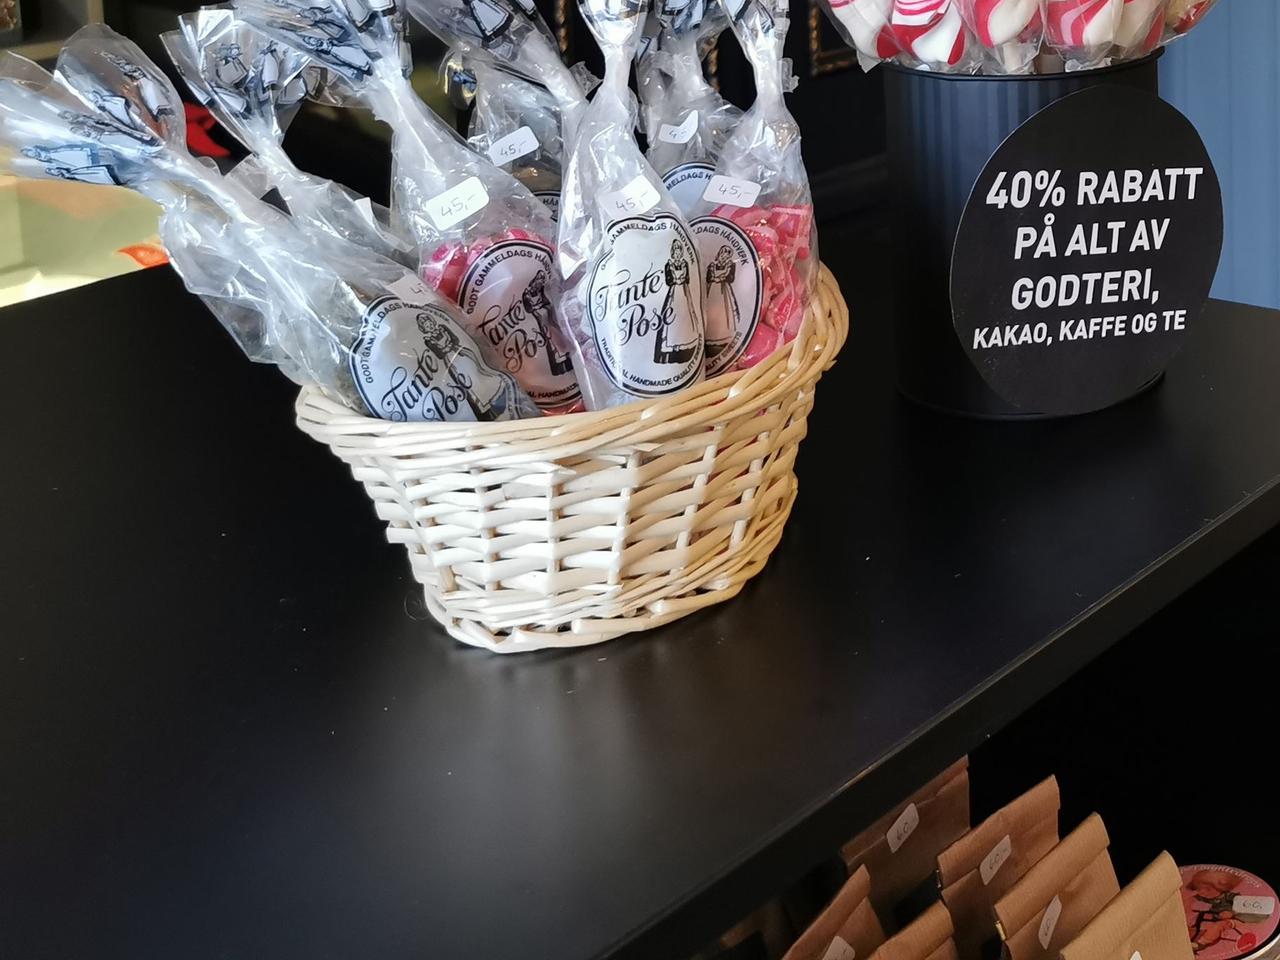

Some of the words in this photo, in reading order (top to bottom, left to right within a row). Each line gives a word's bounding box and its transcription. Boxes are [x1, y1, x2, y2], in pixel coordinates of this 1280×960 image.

[500, 141, 527, 156] 45,-
[615, 191, 649, 209] 45,-
[666, 171, 704, 192] MELDAGS
[718, 183, 753, 199] 45,-
[986, 168, 1066, 209] 40%
[1077, 167, 1203, 205] RABATT
[441, 193, 476, 217] 45,-
[1014, 213, 1057, 259] PÅ
[1065, 221, 1125, 257] ALT
[1130, 218, 1170, 252] AV
[466, 289, 481, 315] GODT
[476, 249, 533, 287] GAMMELDAGS
[1011, 268, 1160, 311] GODTERI,
[476, 294, 527, 346] Tante
[618, 302, 677, 346] Pose
[973, 322, 1053, 350] KAKAO,
[1059, 315, 1127, 341] KAFFE
[1131, 312, 1158, 333] OG
[1162, 310, 1187, 330] TE
[360, 356, 374, 384] GODT
[381, 347, 439, 422] Tante
[629, 373, 673, 387] HANDMADE
[673, 360, 696, 383] QUALITY
[421, 373, 473, 422] Pose
